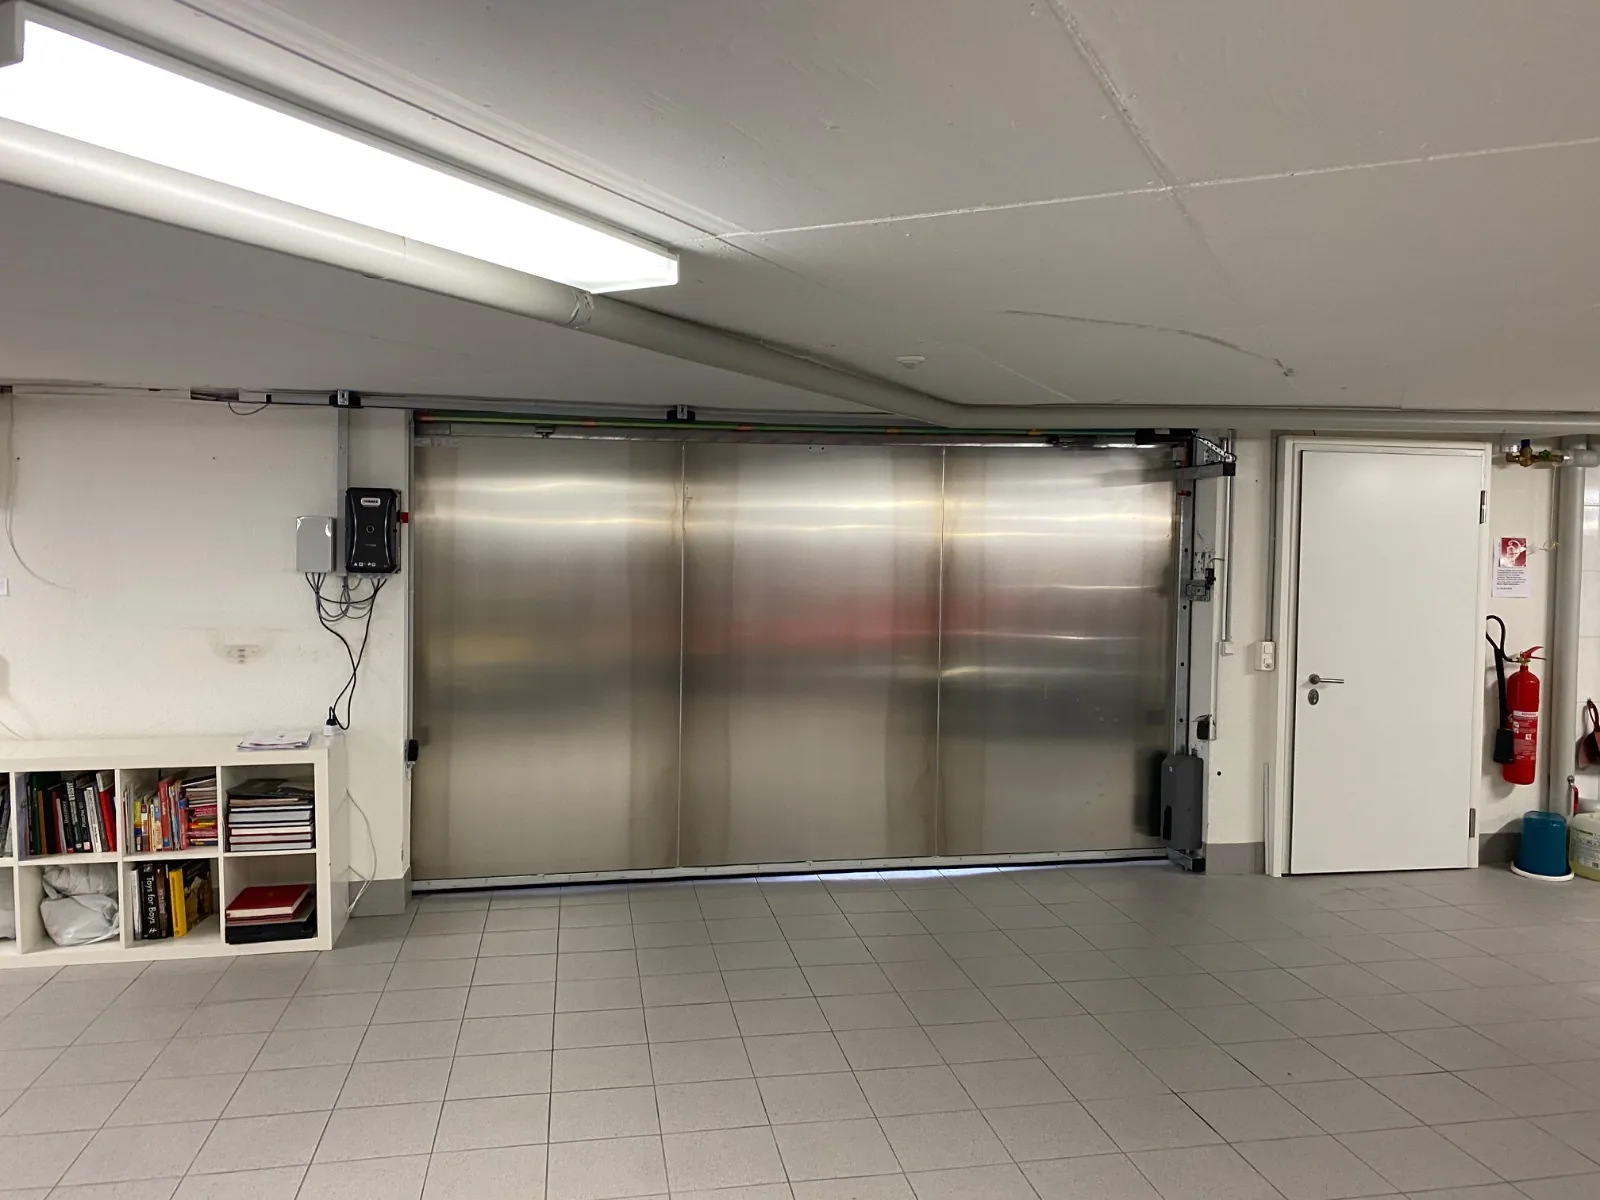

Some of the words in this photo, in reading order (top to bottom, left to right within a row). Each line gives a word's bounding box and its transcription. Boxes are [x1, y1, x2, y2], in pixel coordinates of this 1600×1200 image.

[145, 875, 154, 893] Toys
[147, 894, 156, 906] for
[147, 906, 157, 924] Boys
